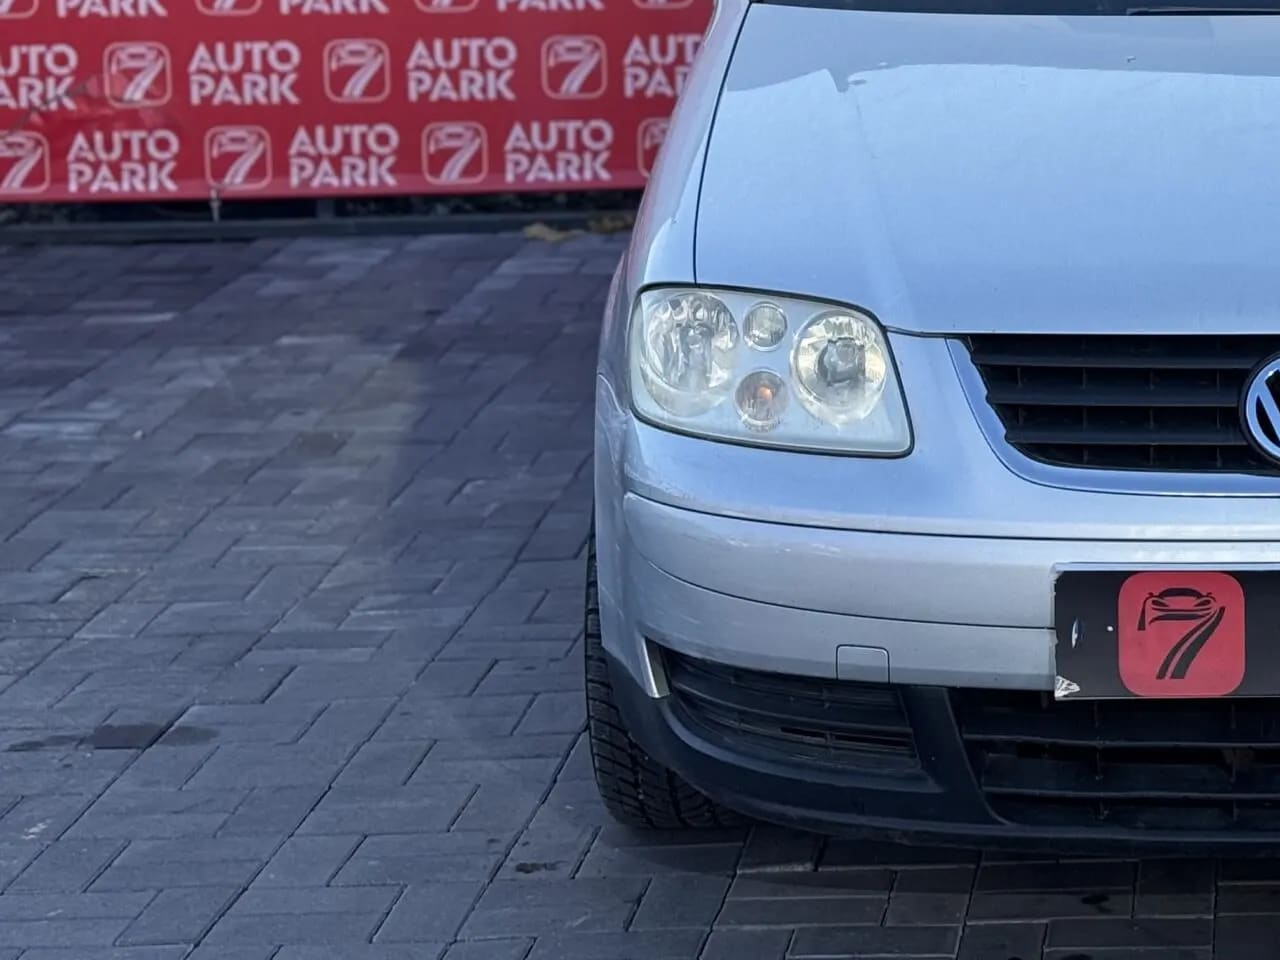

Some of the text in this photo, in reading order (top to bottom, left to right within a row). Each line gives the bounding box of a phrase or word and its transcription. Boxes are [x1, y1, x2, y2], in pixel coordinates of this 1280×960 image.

[188, 40, 300, 73] AUTO
[406, 37, 517, 70] AUTO
[190, 73, 299, 105] PARK
[408, 68, 515, 102] PARK
[67, 129, 179, 162] AUTO
[289, 123, 399, 155] AUTO
[504, 119, 613, 151] AUTO
[68, 161, 178, 193] PARK
[290, 154, 398, 187] PARK
[505, 150, 612, 182] PARK
